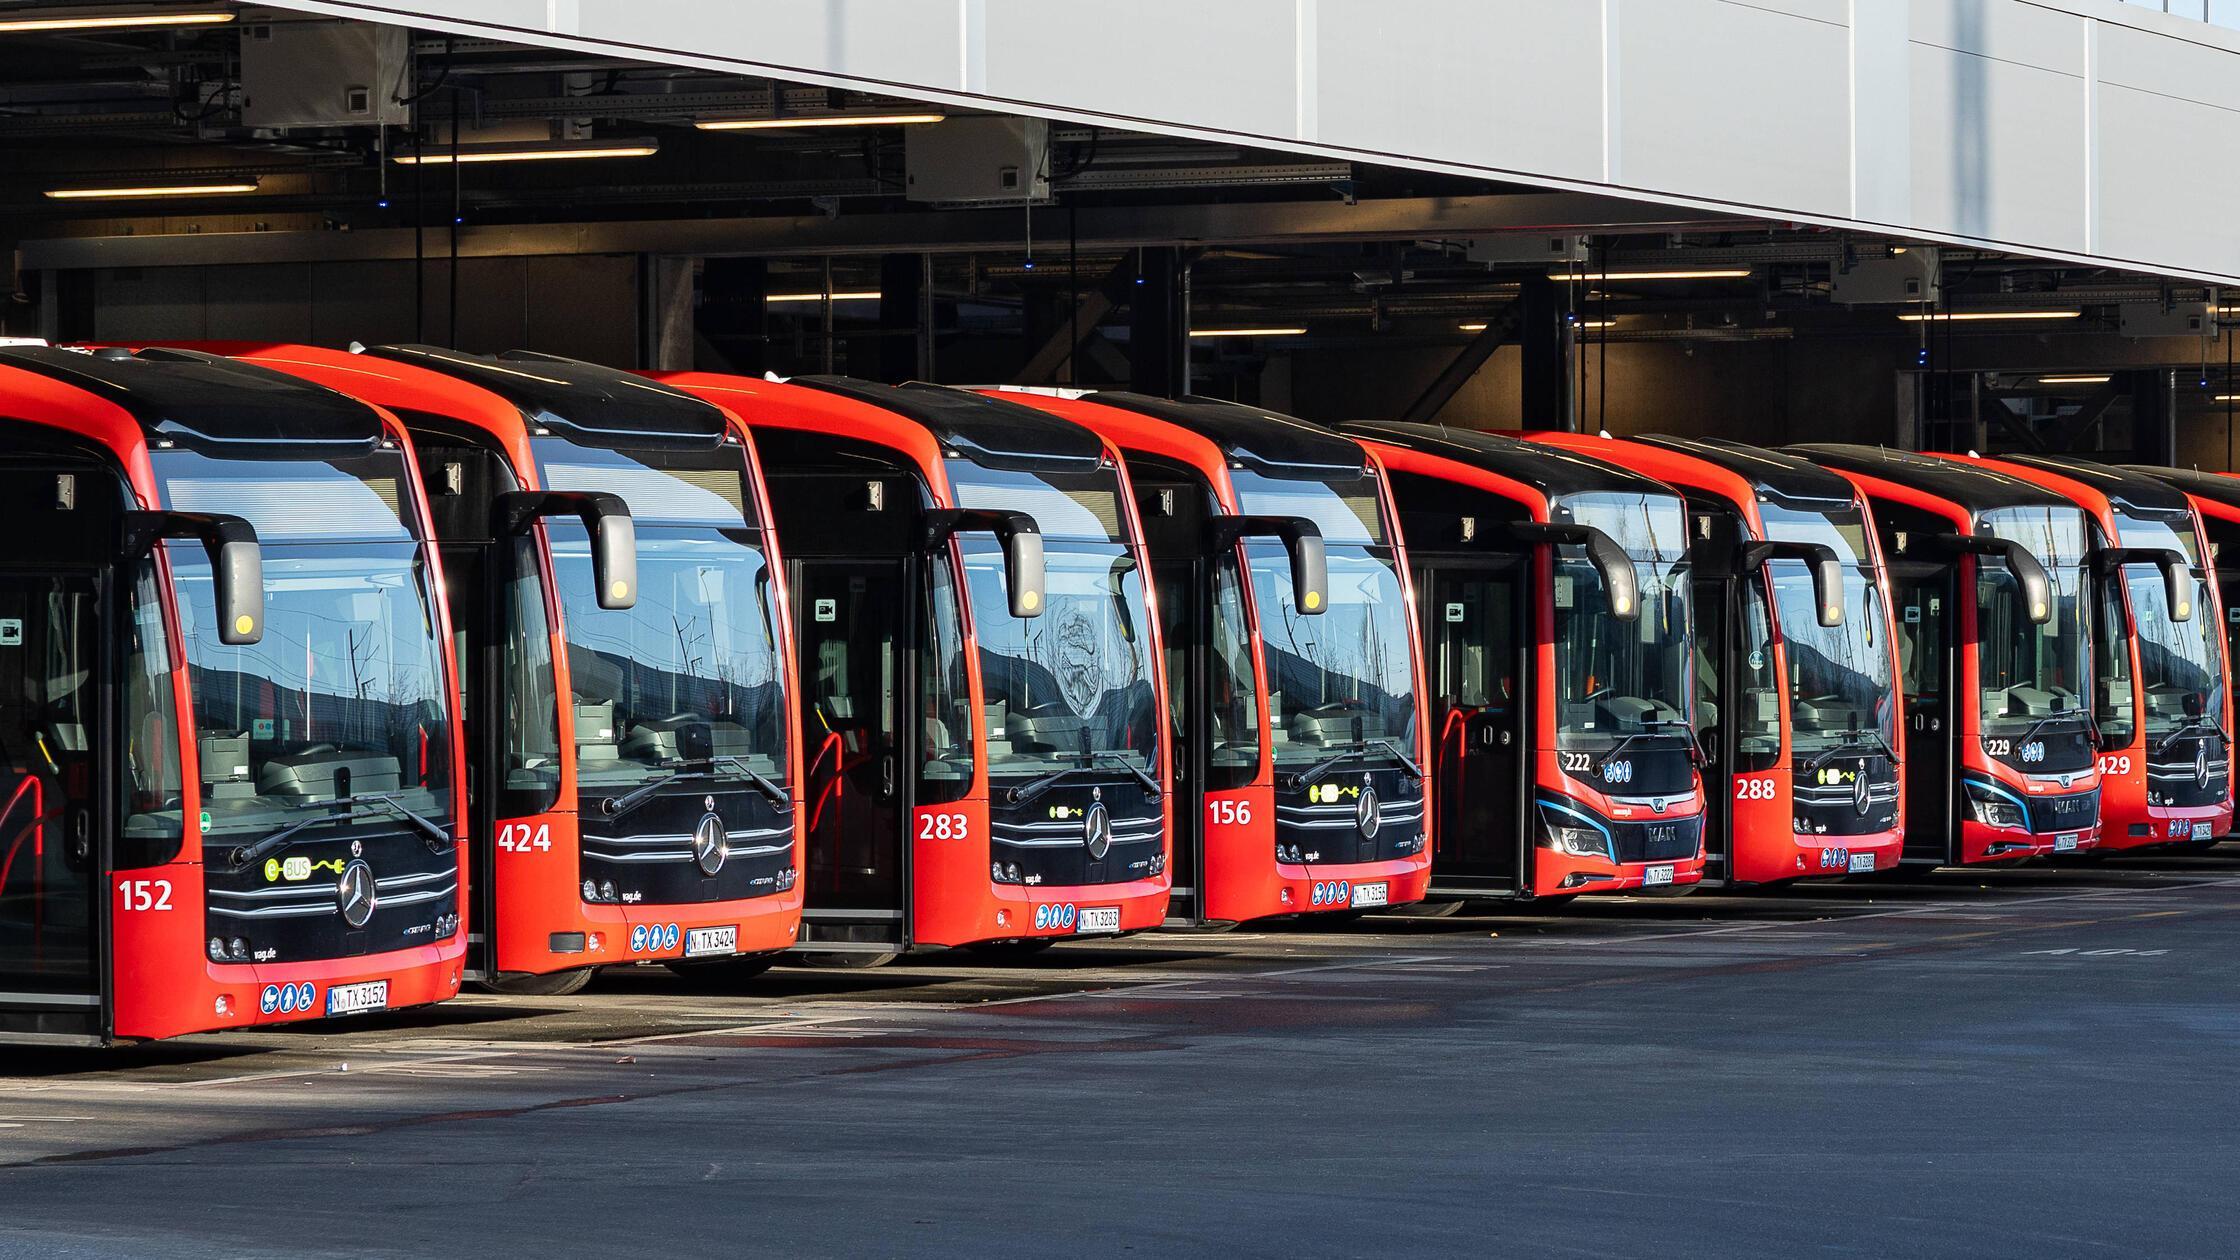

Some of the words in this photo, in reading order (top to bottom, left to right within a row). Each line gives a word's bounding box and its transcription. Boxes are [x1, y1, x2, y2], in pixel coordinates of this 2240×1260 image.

[1989, 739, 2010, 756] 229
[1565, 753, 1590, 771] 222
[2099, 756, 2131, 775] 429
[1736, 779, 1776, 800] 288
[1209, 800, 1252, 825] 156
[919, 813, 968, 840] 283
[1648, 826, 1676, 842] MAN
[498, 823, 552, 852] 424
[285, 861, 308, 876] BUS
[118, 879, 173, 911] 152
[622, 890, 642, 904] vag.de
[1371, 886, 1386, 900] 3156
[1100, 911, 1118, 927] 3283
[702, 932, 713, 949] TX
[714, 930, 735, 948] 3424
[254, 947, 277, 962] vag.de
[333, 991, 340, 1009] N
[347, 989, 359, 1008] TX
[360, 985, 385, 1006] 3152
